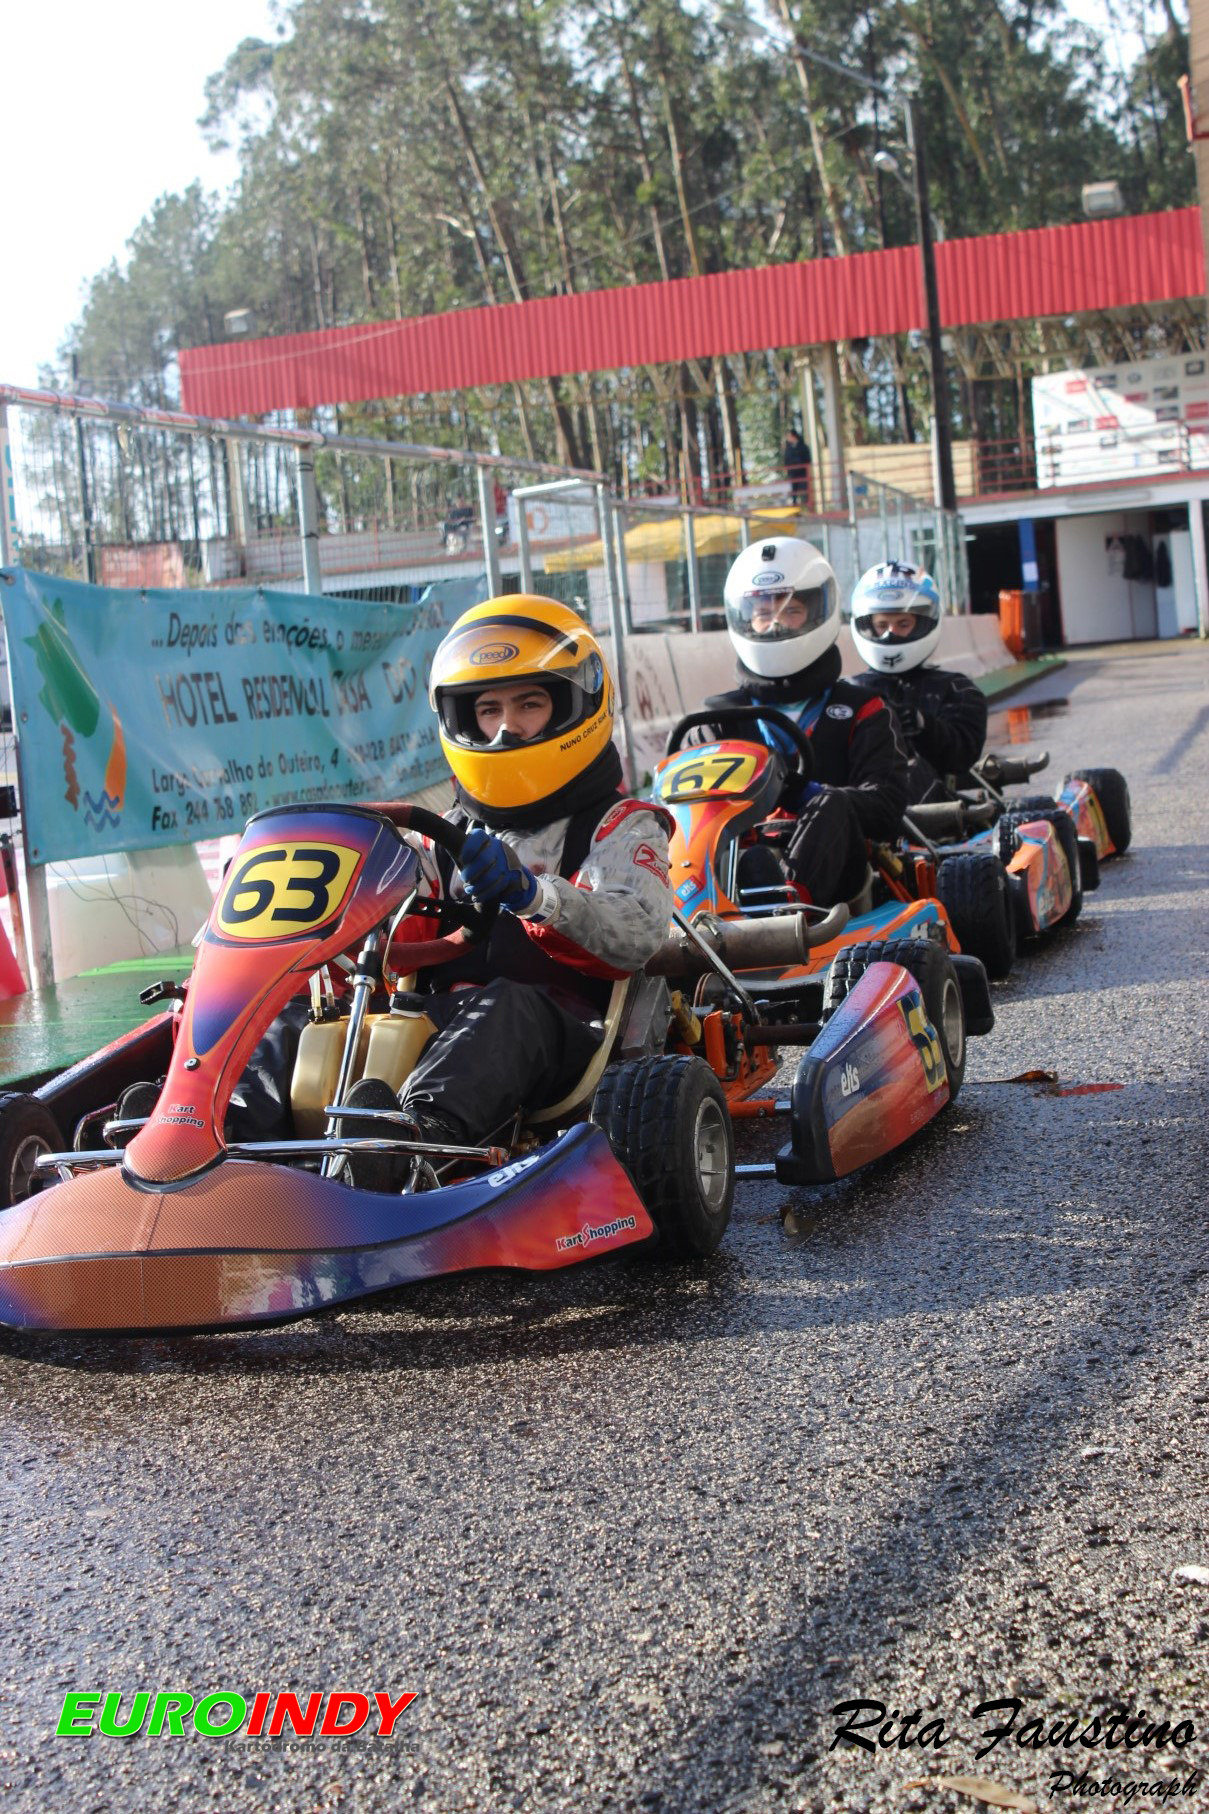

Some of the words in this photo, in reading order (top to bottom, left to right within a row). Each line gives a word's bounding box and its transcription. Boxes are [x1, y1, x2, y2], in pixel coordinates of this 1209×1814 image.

[155, 671, 239, 728] HOTEL
[559, 735, 582, 752] NUNO
[258, 755, 273, 779] do
[671, 757, 746, 794] 67
[151, 805, 178, 832] Fax
[221, 848, 341, 925] 63
[168, 1104, 196, 1114] Kart
